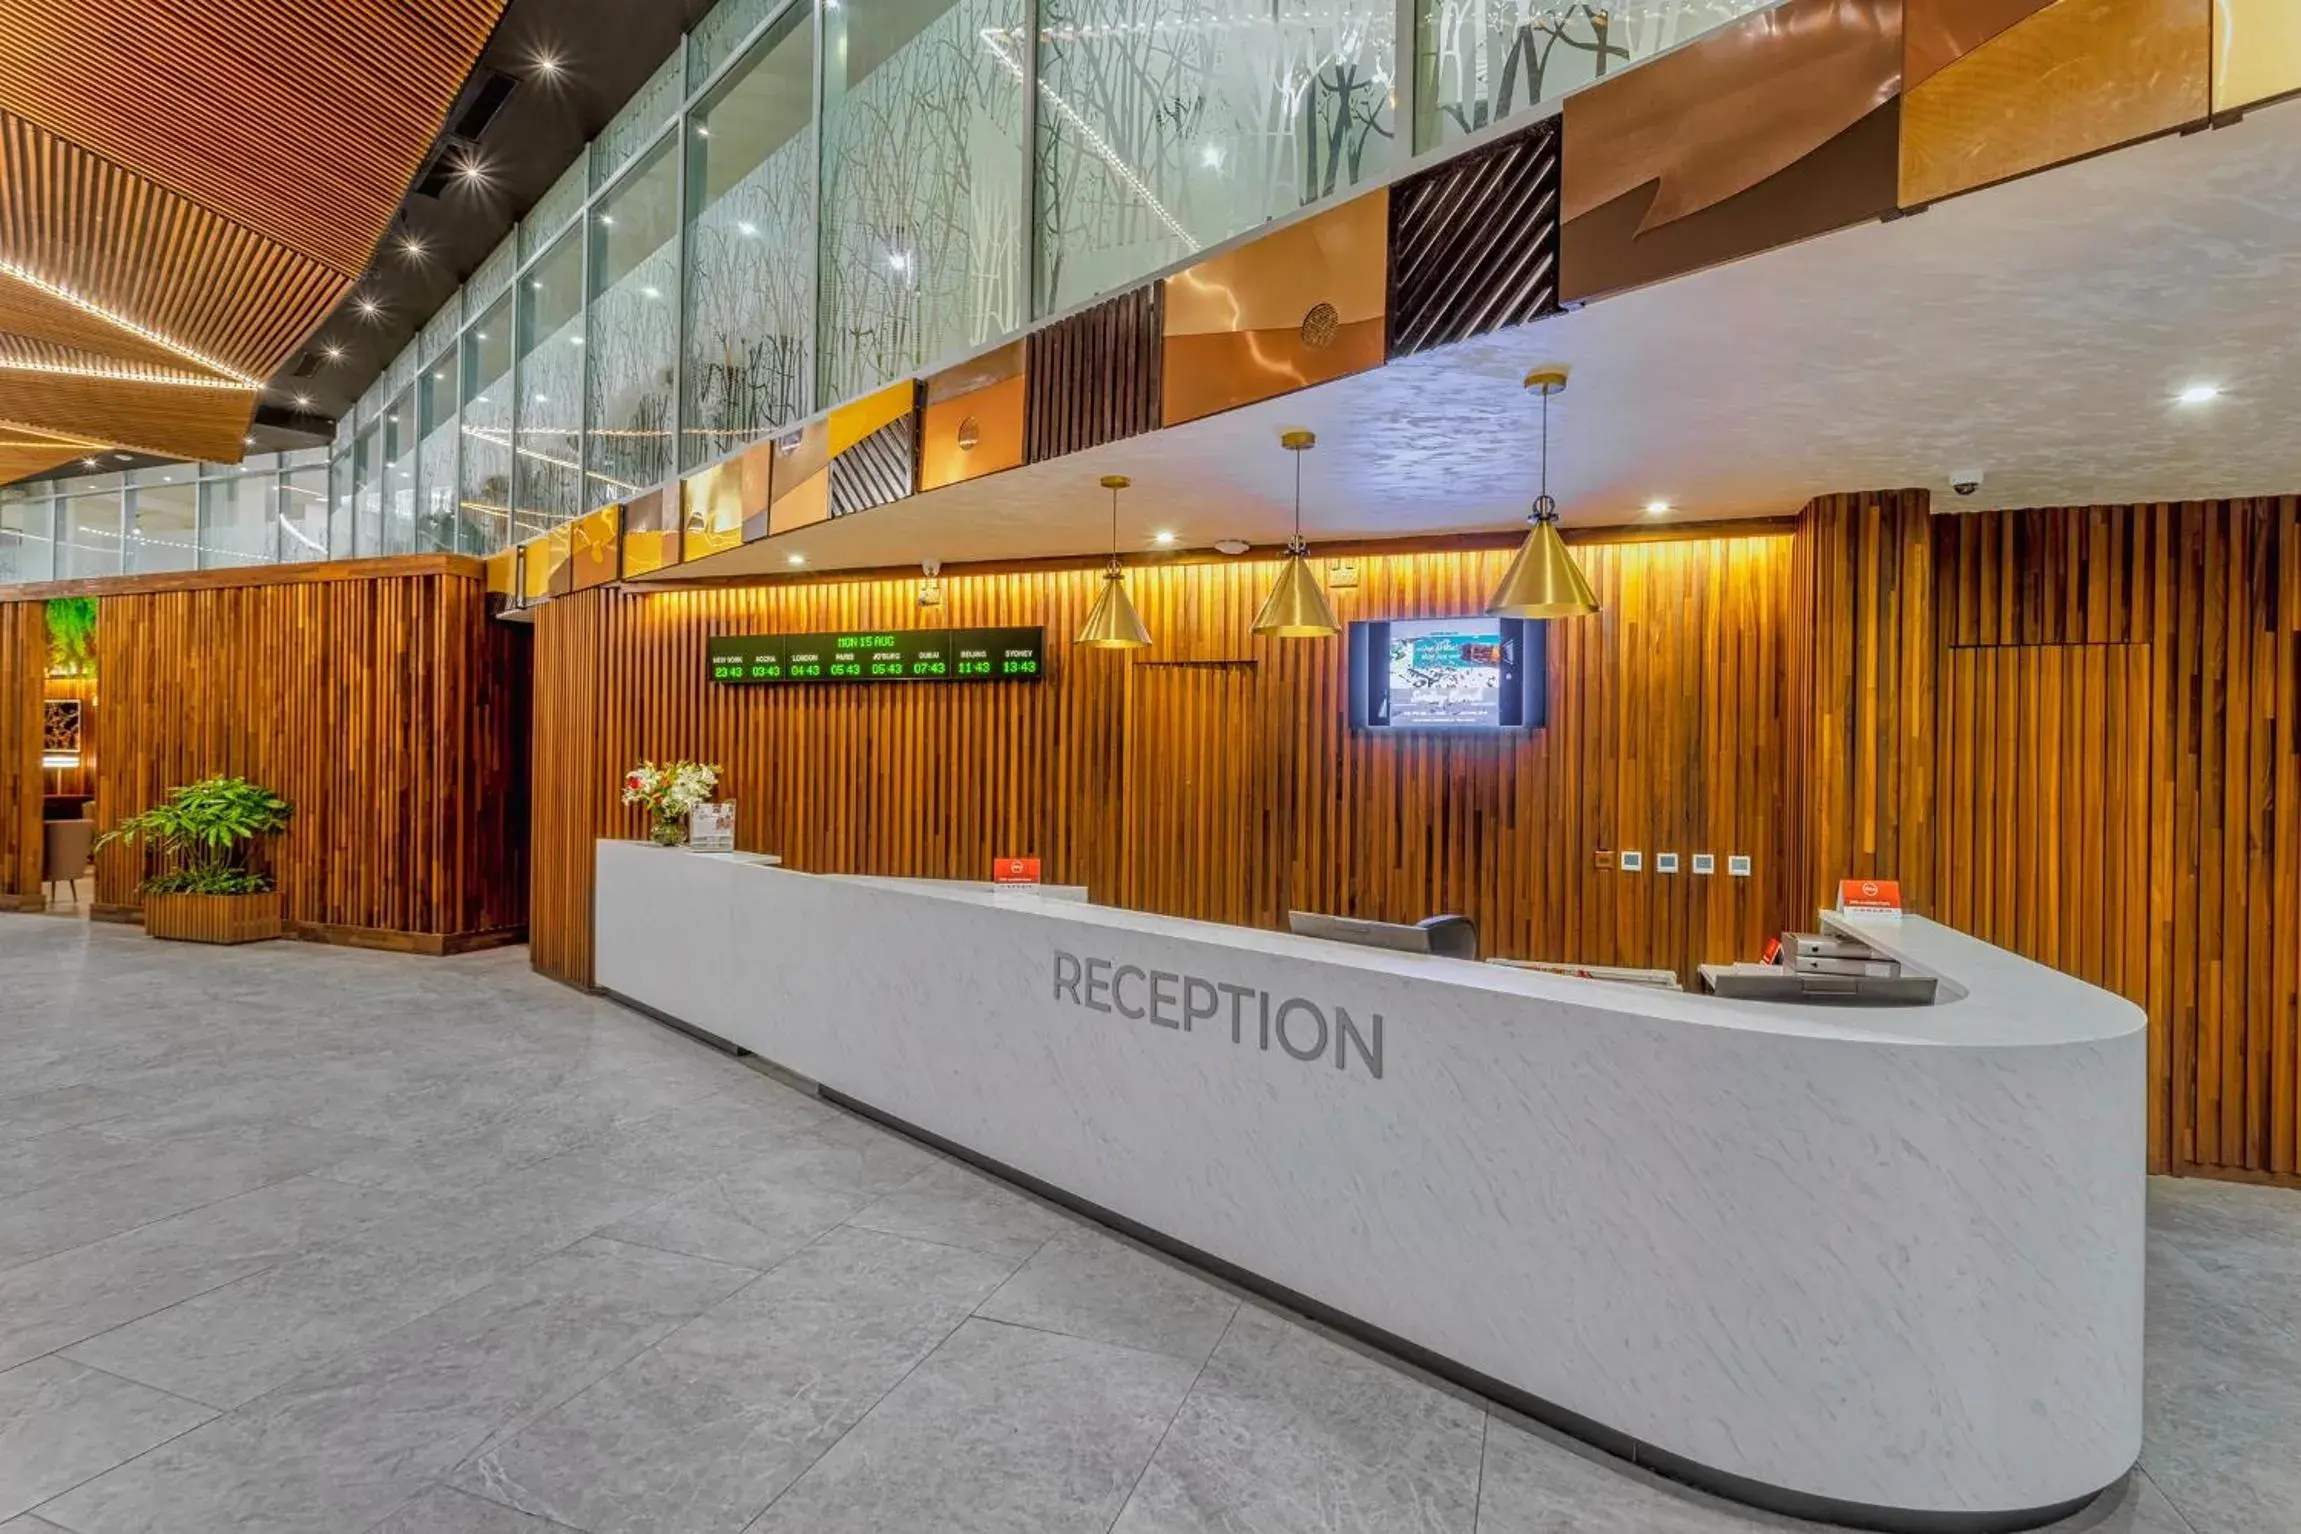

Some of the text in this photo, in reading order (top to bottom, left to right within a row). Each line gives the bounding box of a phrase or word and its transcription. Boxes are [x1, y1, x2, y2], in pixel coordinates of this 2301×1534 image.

[838, 636, 895, 649] MON 15 AUG
[1005, 649, 1033, 658] SYDNEY
[914, 662, 946, 674] 07:43
[1004, 660, 1036, 673] 13:43
[1053, 950, 1383, 1080] RECEPTION
